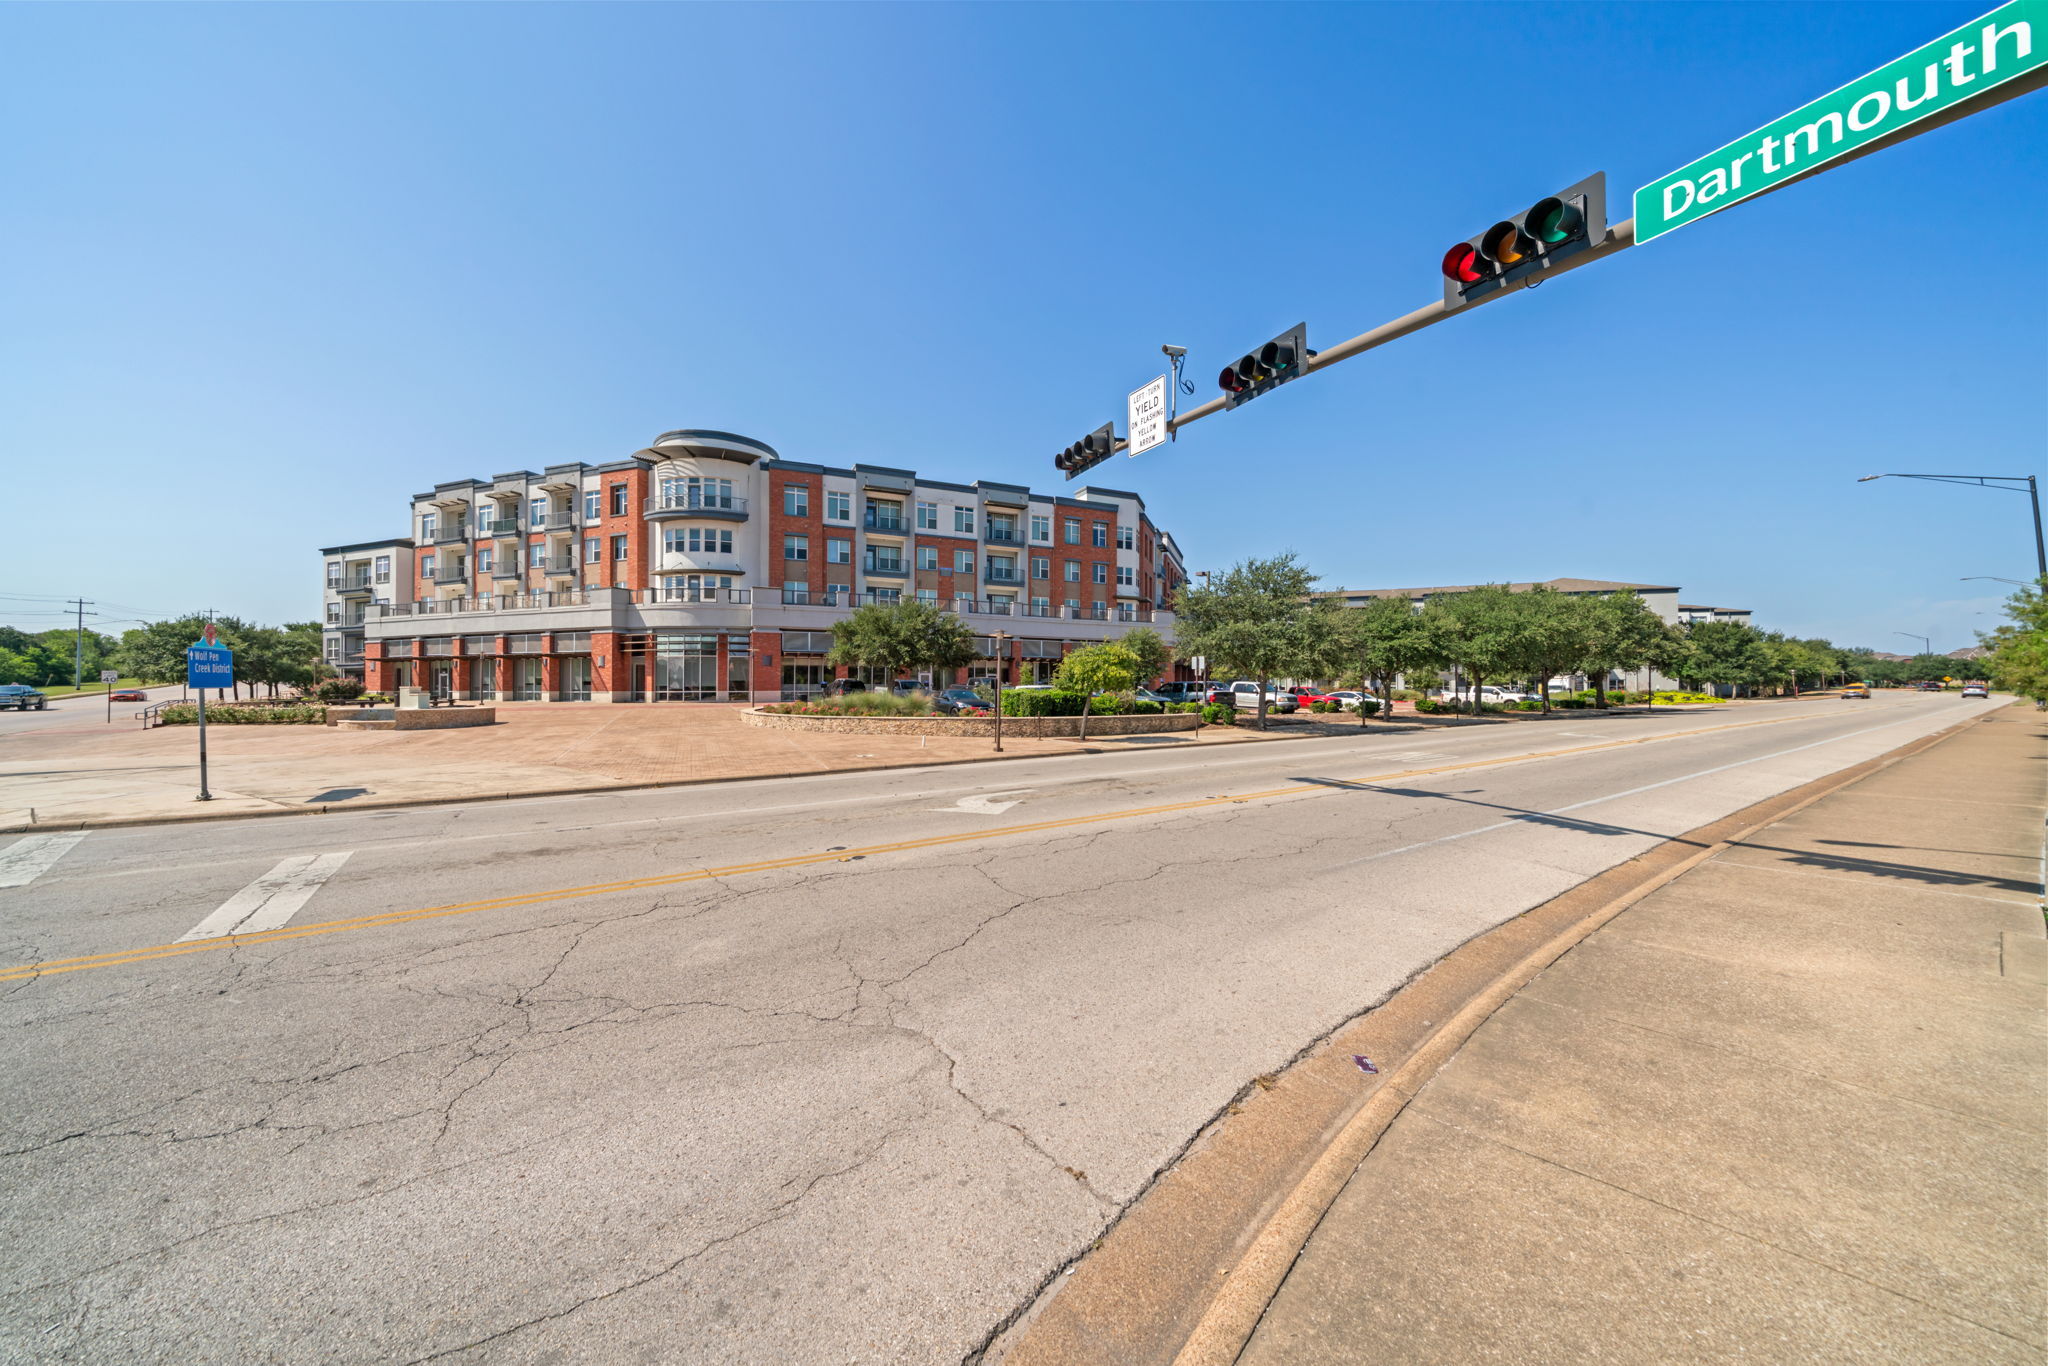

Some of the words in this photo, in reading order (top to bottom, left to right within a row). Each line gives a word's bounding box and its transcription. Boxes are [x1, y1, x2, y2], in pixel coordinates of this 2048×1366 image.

[1663, 20, 2032, 222] Dartmouth
[1134, 392, 1145, 404] LEFT
[1148, 383, 1160, 396] TURN
[1135, 396, 1159, 416] YIELD
[1131, 422, 1138, 430] ON
[1140, 407, 1164, 425] FLASHING
[1138, 422, 1157, 437] YELLOW
[1139, 434, 1156, 447] ARROW
[194, 651, 208, 661] Wolf
[209, 652, 220, 661] Pen
[195, 663, 211, 673] Creek
[212, 664, 231, 674] District
